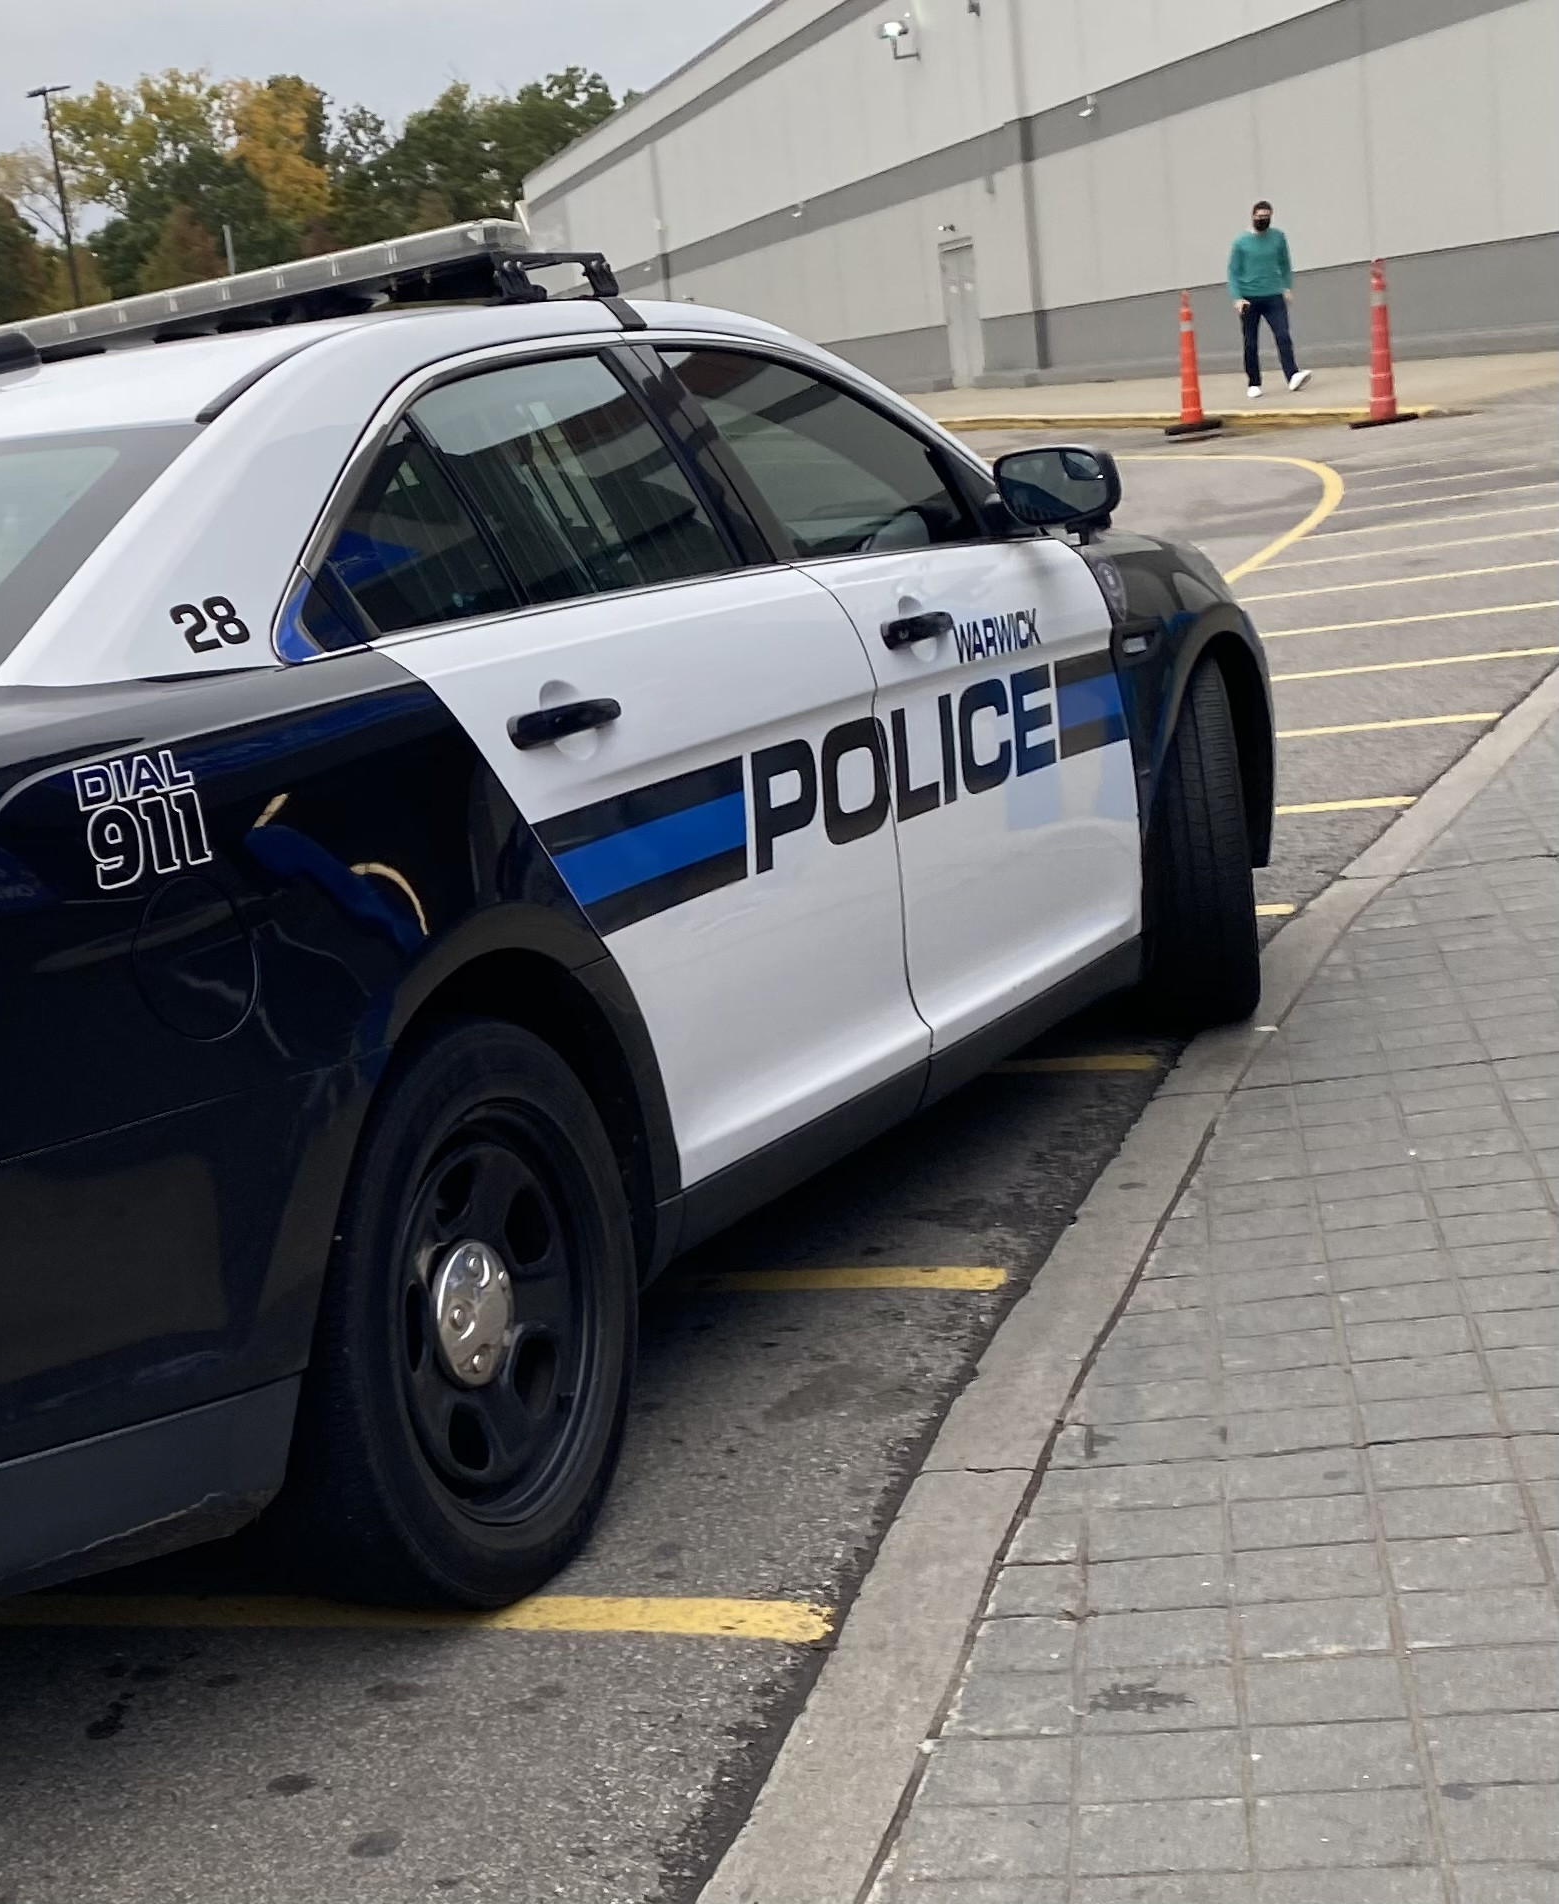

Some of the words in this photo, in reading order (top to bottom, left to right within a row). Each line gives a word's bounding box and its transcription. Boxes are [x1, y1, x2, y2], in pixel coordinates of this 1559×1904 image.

[169, 595, 251, 654] 28
[953, 608, 1042, 664] WARWICK
[73, 749, 195, 812] DIAL
[750, 663, 1057, 875] POLICE
[87, 788, 213, 890] 911
